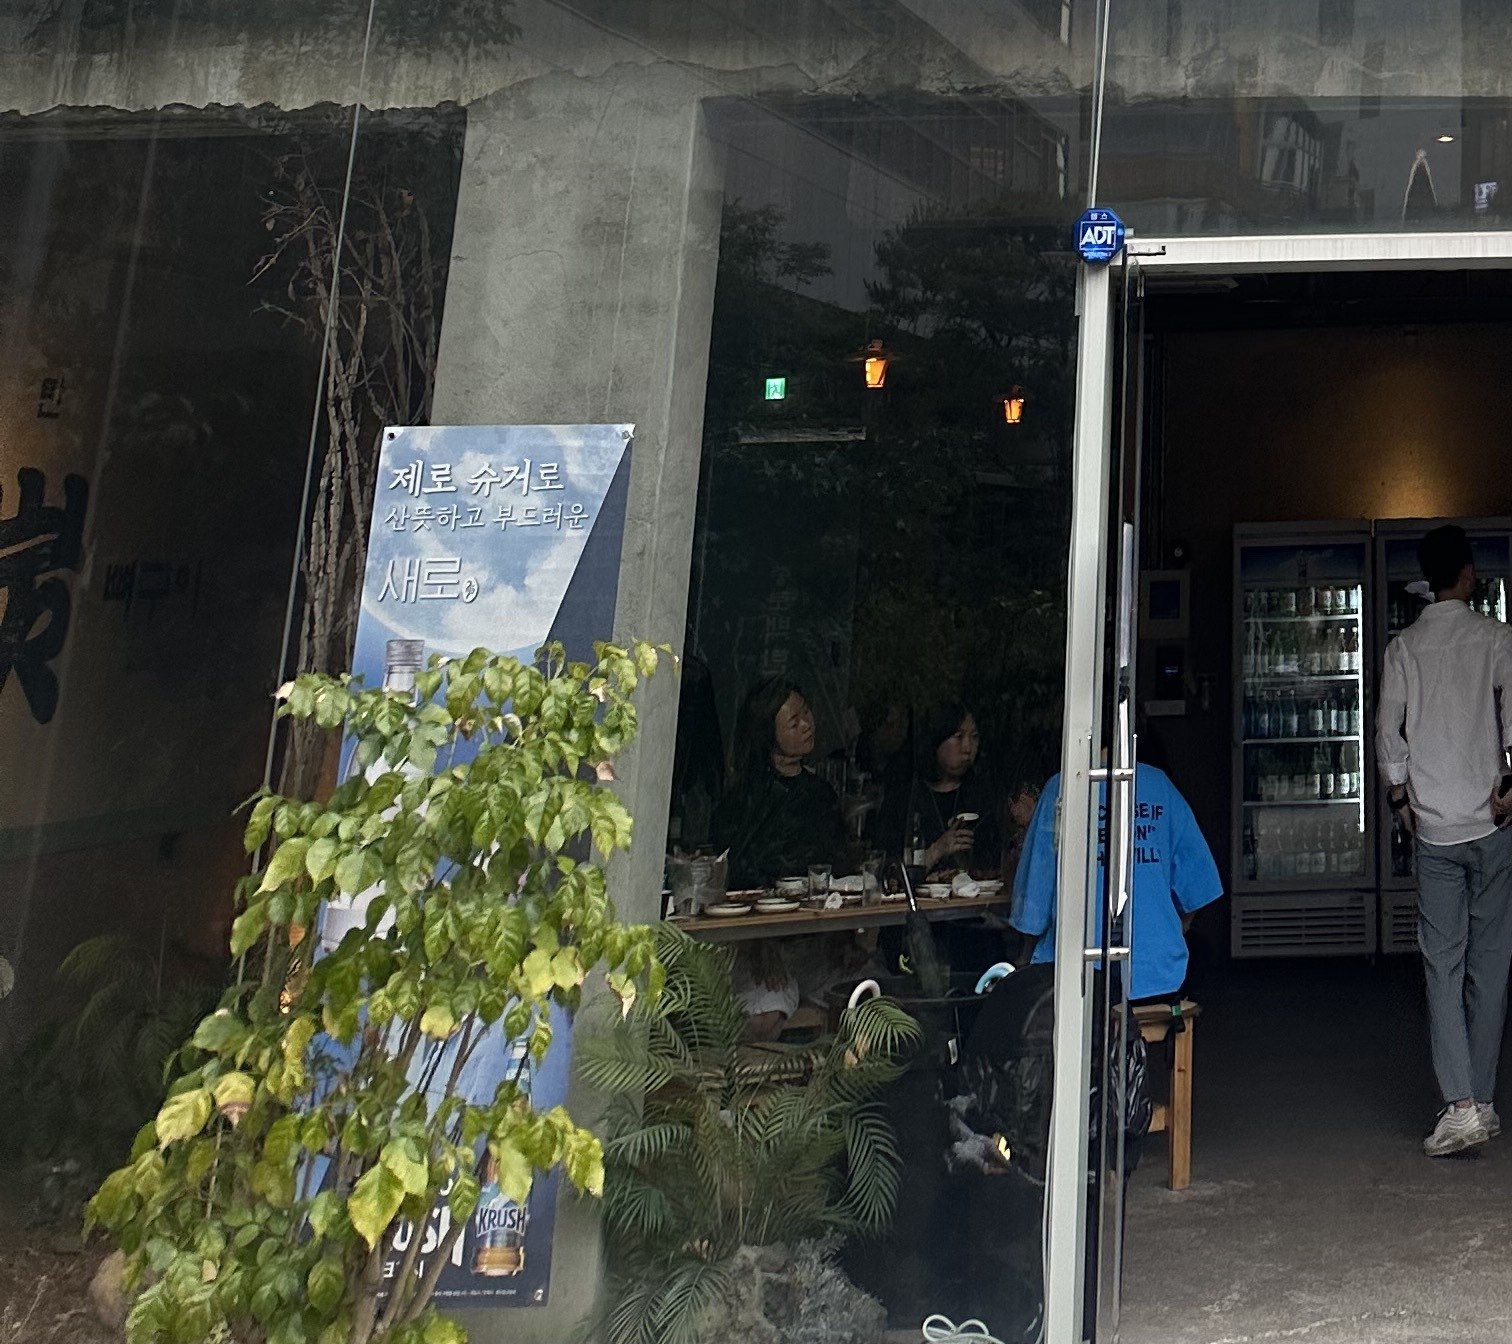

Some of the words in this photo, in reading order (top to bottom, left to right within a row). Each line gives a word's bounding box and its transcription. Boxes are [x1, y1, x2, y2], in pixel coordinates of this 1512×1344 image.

[1081, 226, 1116, 245] ADT
[388, 459, 457, 497] 제로
[467, 458, 564, 497] 슈거로
[384, 503, 485, 532] 산뜻하고
[492, 503, 589, 531] 부드러운
[377, 557, 462, 603] 새로
[478, 1206, 527, 1235] KRUSH
